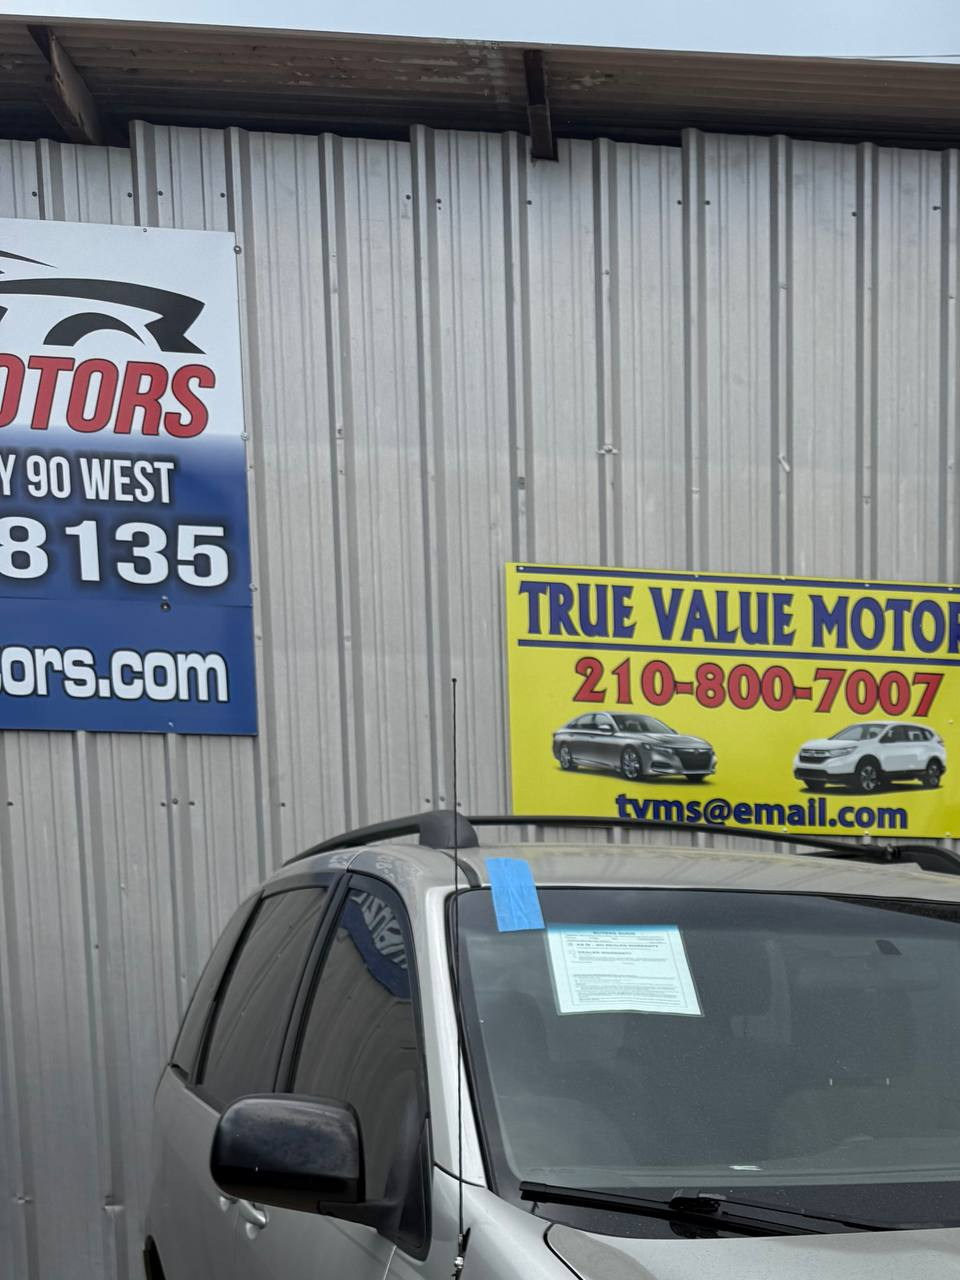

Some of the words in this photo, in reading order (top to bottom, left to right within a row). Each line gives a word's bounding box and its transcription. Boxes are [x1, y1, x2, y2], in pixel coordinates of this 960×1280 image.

[26, 455, 71, 499] 90
[80, 457, 175, 504] WEST
[0, 516, 229, 587] 8135
[518, 580, 637, 638] TRUE
[649, 586, 797, 646] VALUE
[573, 656, 945, 718] 210-800-7007
[615, 793, 908, 829] tvms@email.com
